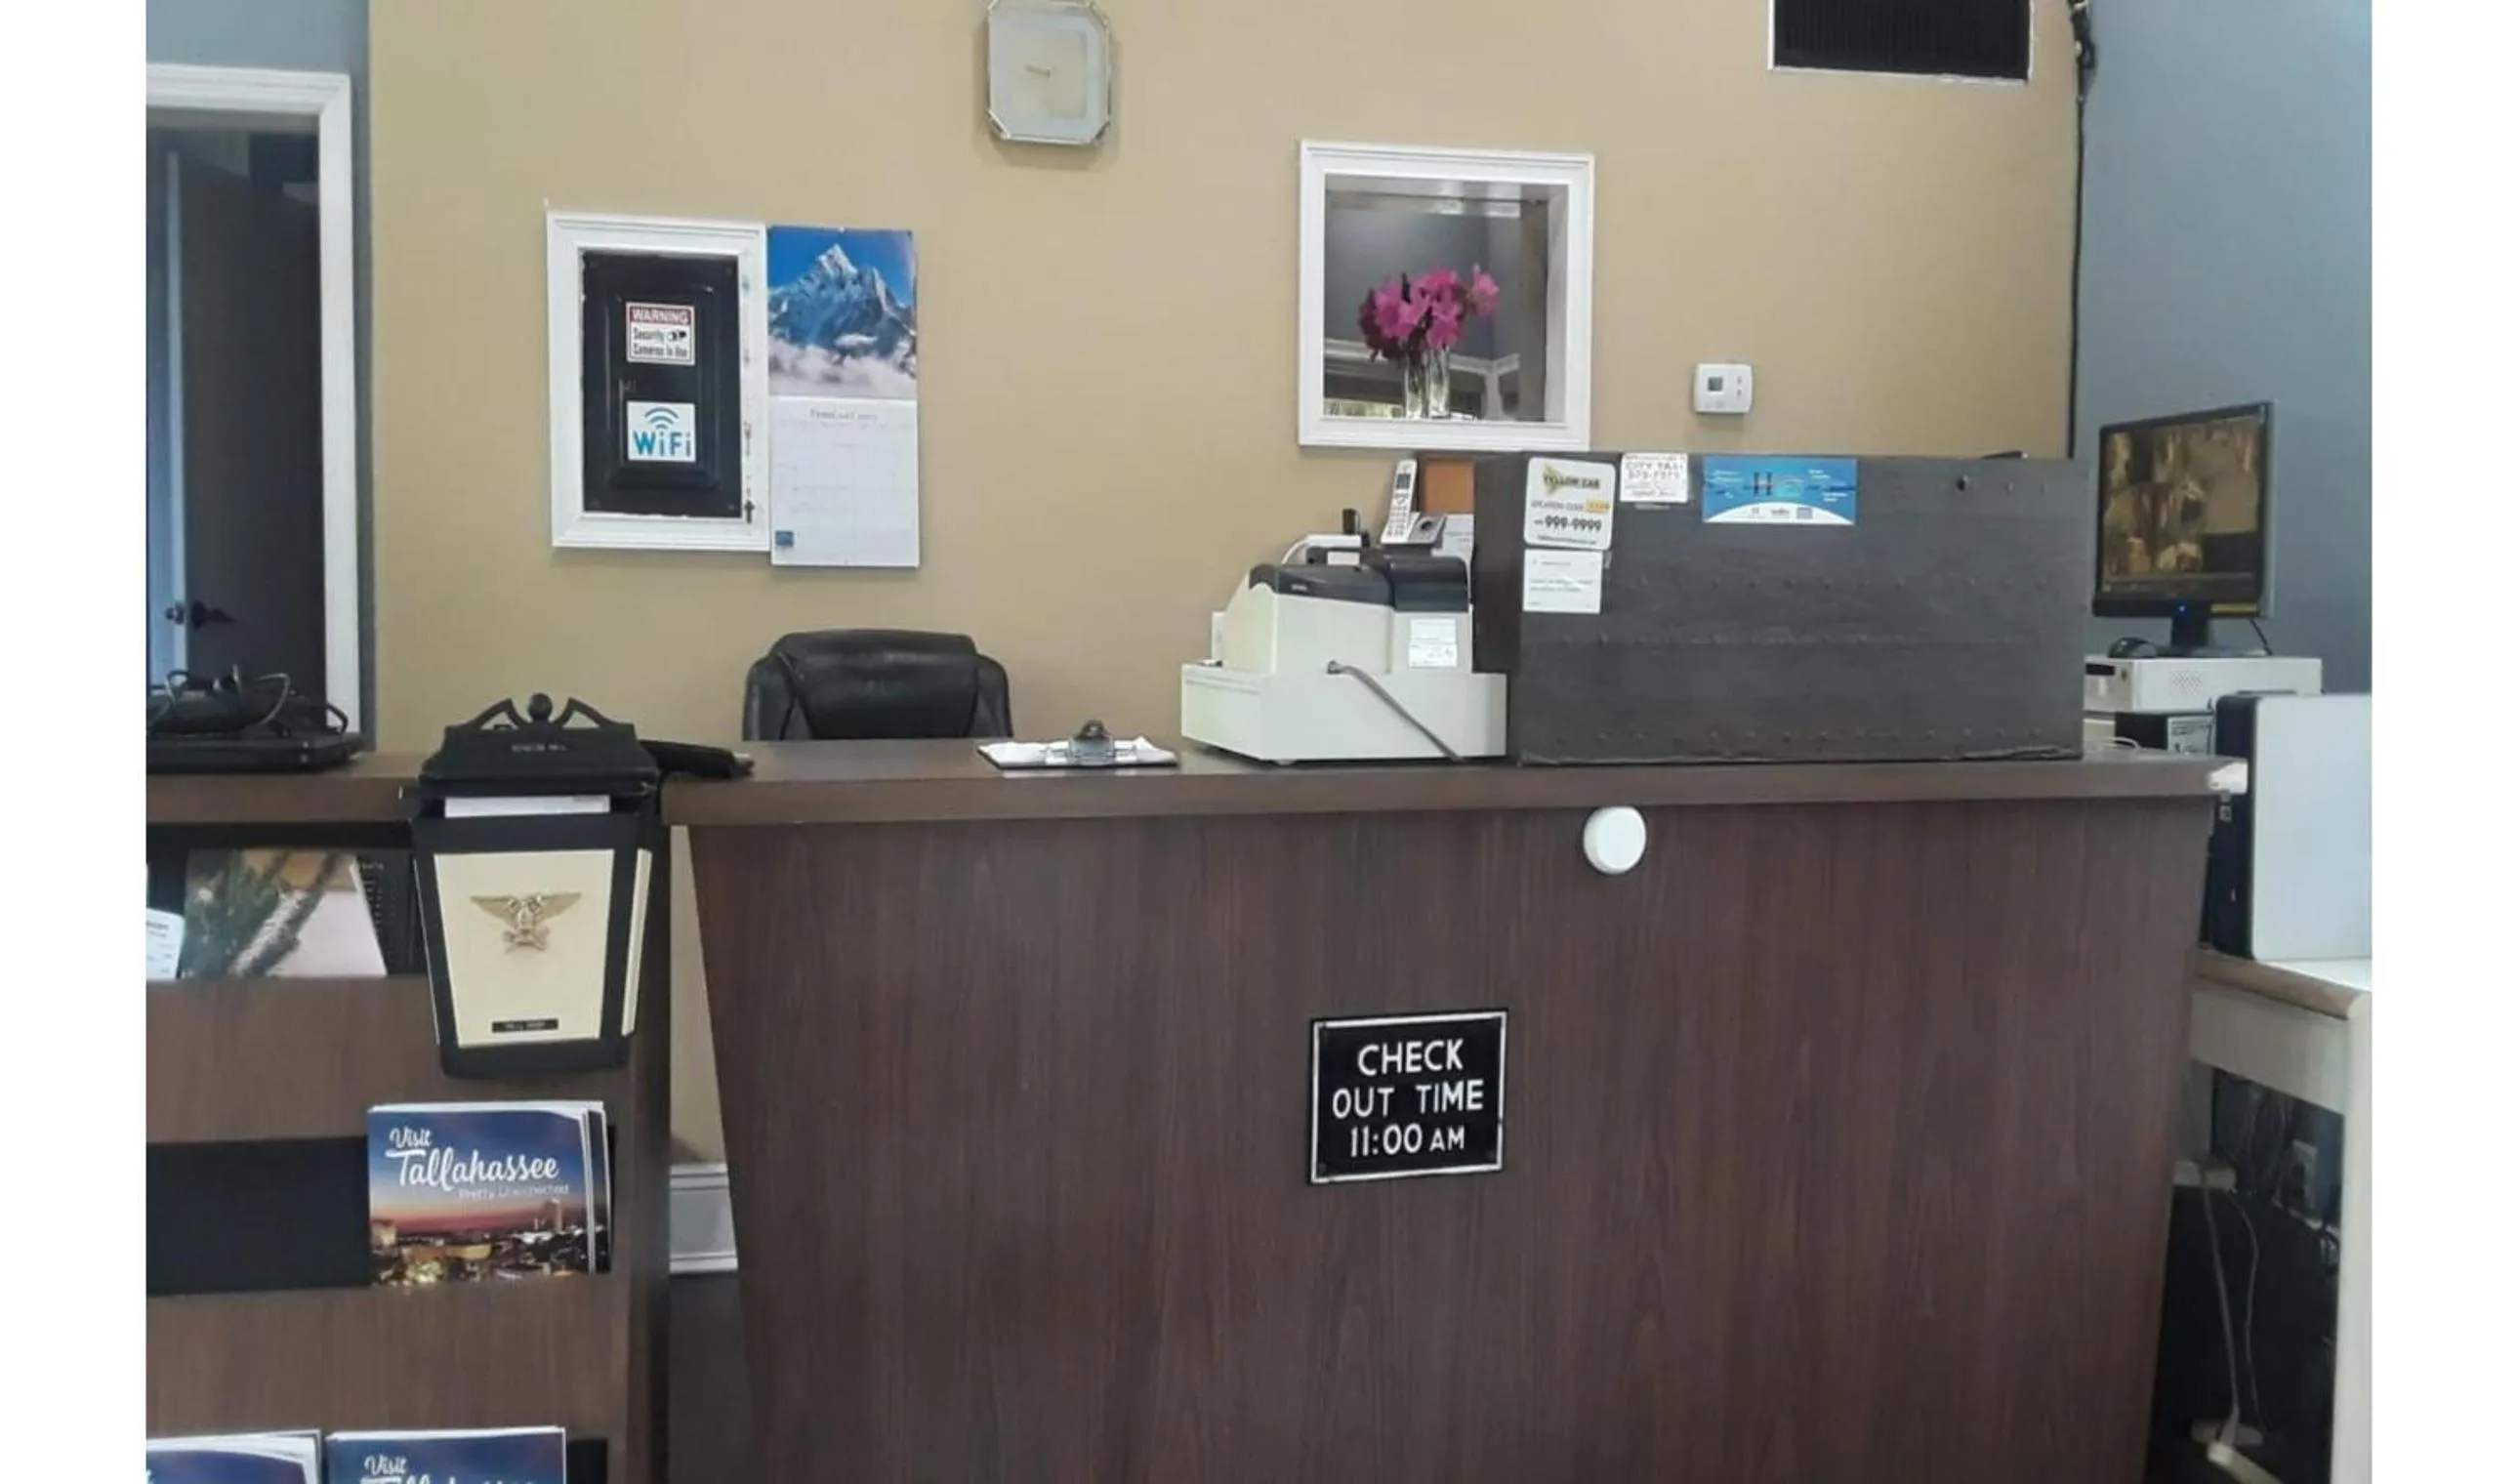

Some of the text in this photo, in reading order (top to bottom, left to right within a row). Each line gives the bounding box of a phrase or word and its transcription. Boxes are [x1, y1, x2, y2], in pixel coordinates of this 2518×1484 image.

[632, 308, 688, 324] WARNING
[633, 326, 665, 344] Security
[633, 343, 664, 356] Cameras
[675, 346, 687, 357] Use
[633, 430, 692, 458] WiFi
[1543, 474, 1600, 489] YELLOW CAB
[1545, 515, 1602, 532] 999-9999
[1357, 1038, 1464, 1076] CHECK
[1332, 1079, 1484, 1119] OUT TIME
[389, 1126, 433, 1149] Visit
[1350, 1123, 1465, 1158] 11:00 AM
[385, 1145, 559, 1191] Tallahassee
[363, 1454, 408, 1476] Visit
